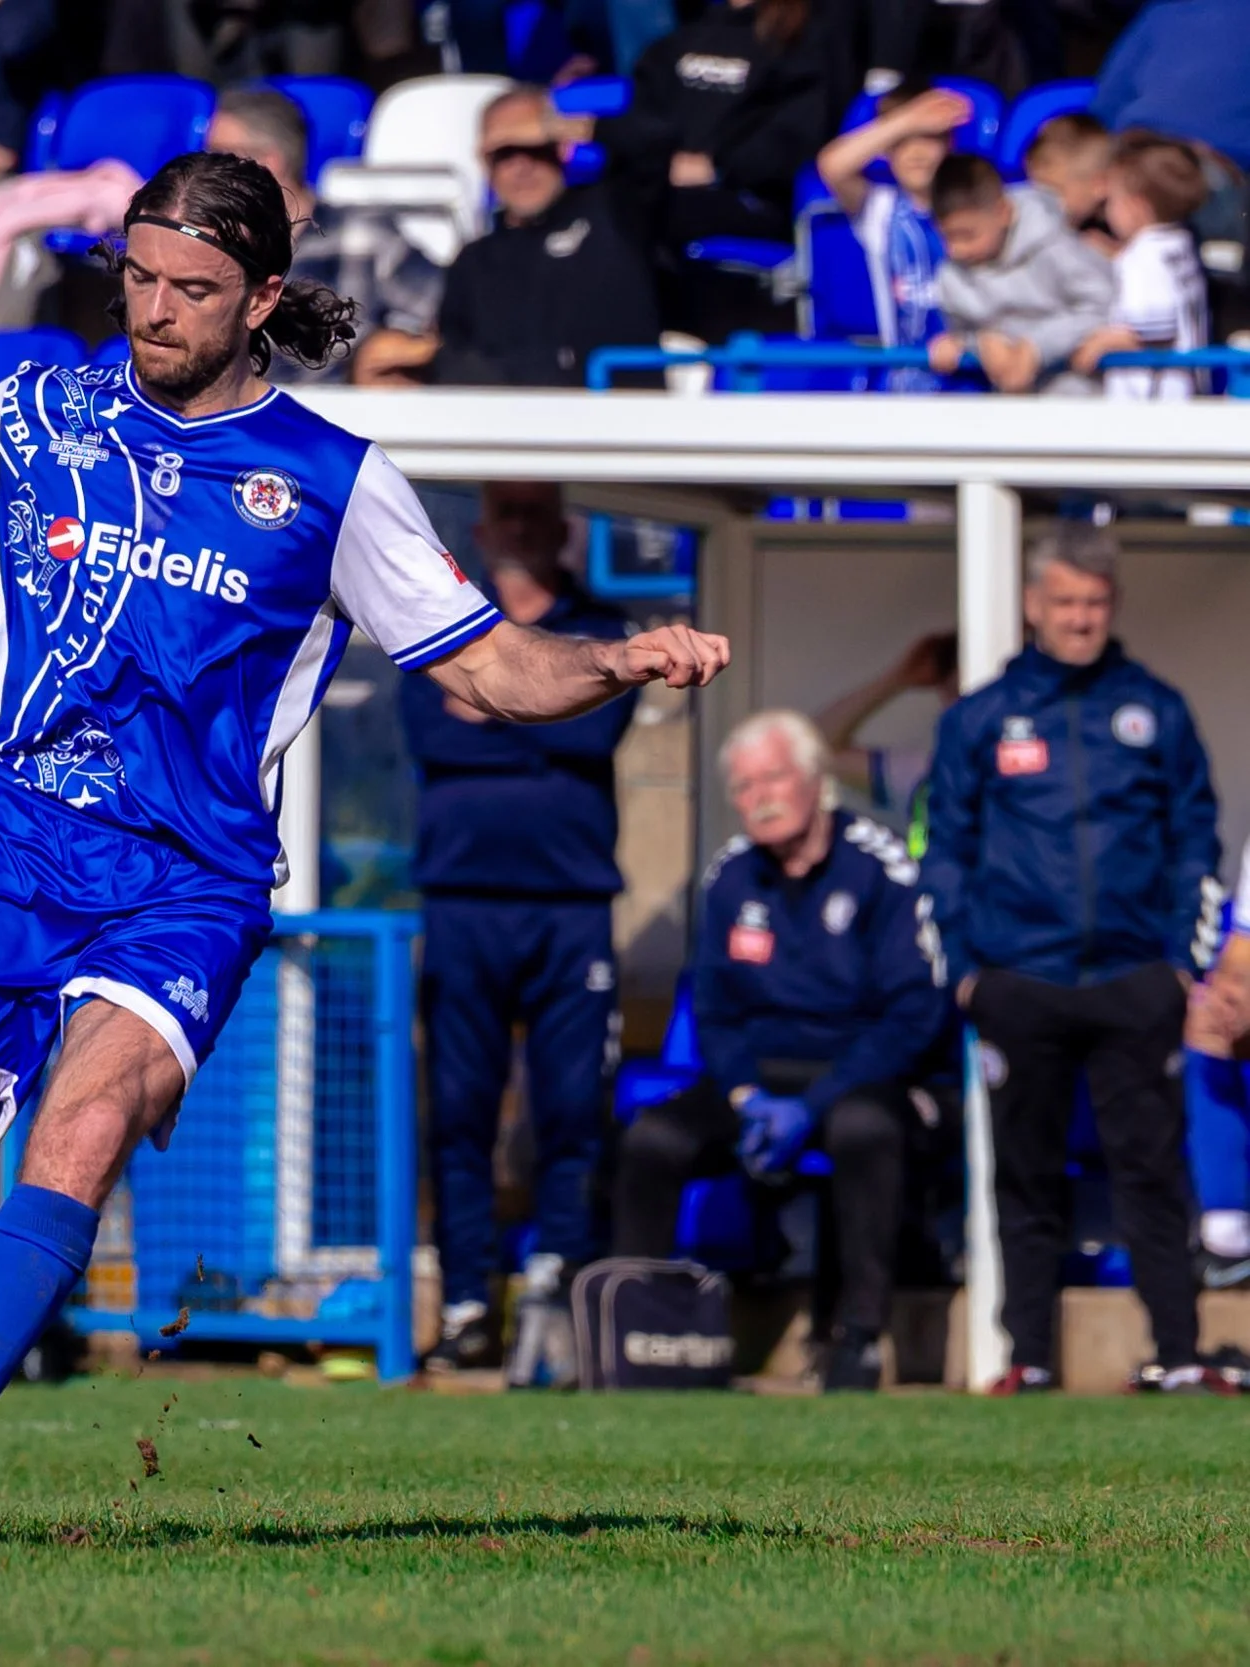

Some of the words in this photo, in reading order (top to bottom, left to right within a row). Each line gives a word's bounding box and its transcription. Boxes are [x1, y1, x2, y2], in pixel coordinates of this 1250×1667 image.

[150, 452, 184, 497] 8
[40, 559, 61, 584] NIHI
[82, 540, 115, 624] CLU
[85, 521, 250, 604] Fidelis
